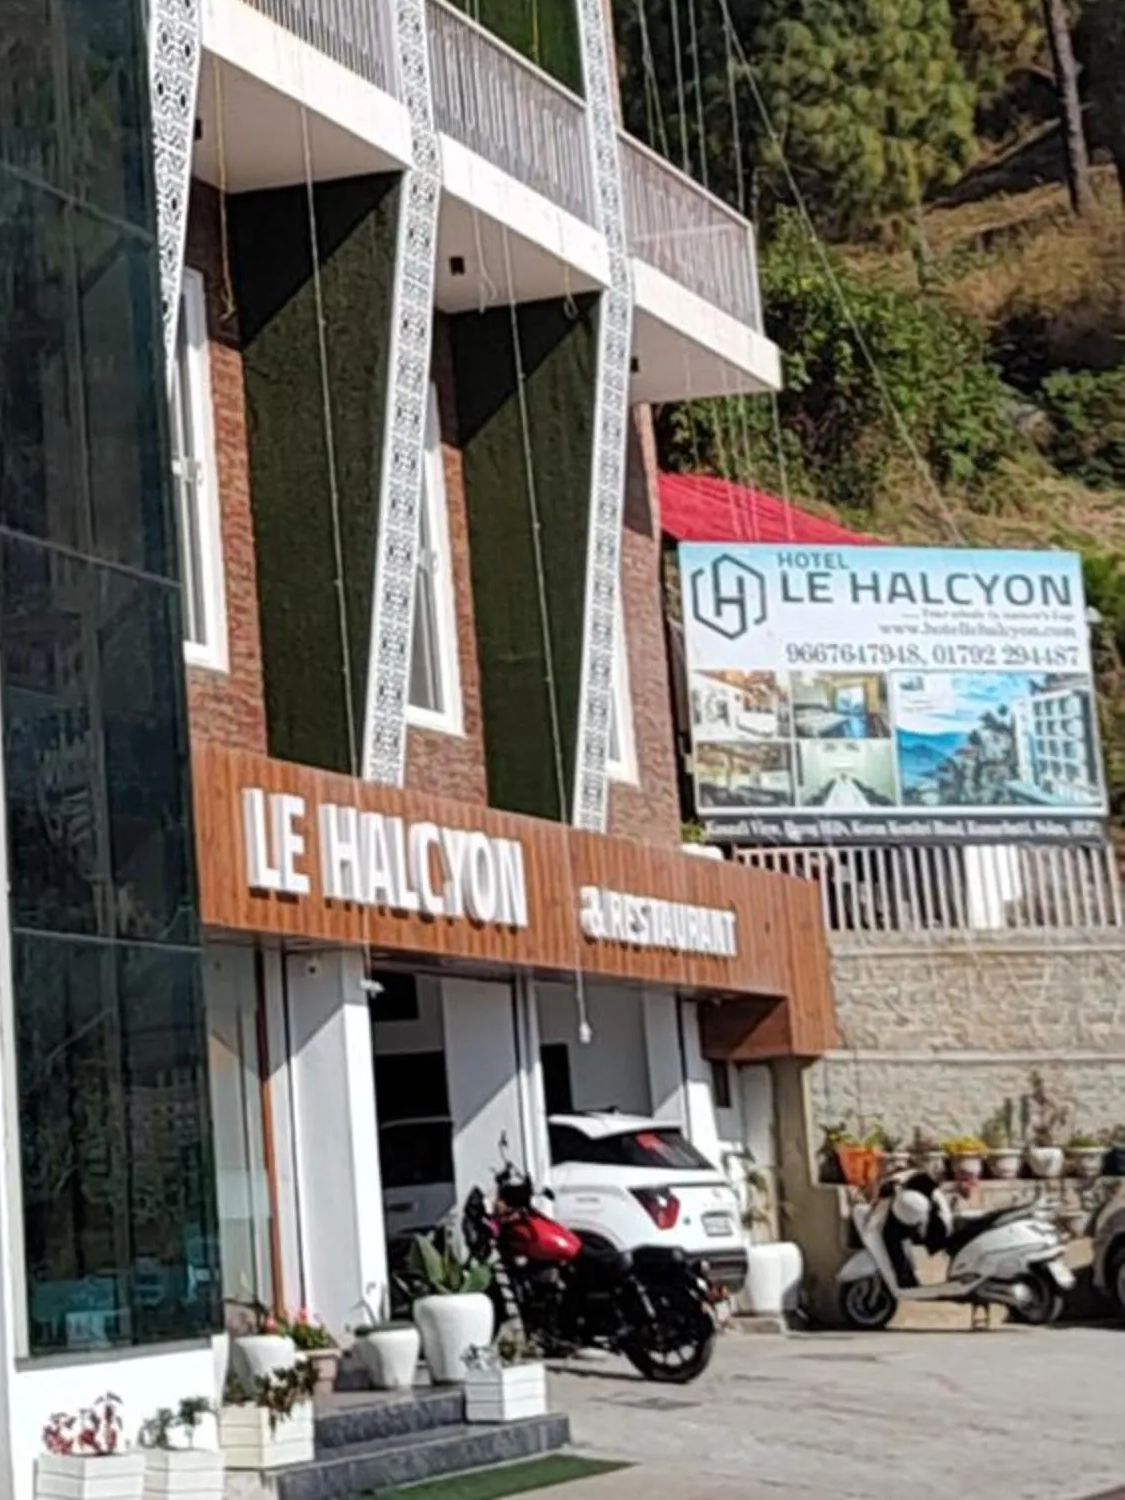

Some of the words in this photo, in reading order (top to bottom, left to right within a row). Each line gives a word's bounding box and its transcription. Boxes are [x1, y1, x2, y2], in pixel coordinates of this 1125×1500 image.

[777, 551, 849, 570] HOTEL
[780, 570, 834, 603] LE
[850, 571, 1072, 607] HALCYON
[241, 787, 310, 896] LE
[317, 802, 529, 928] HALCYON
[601, 887, 739, 958] RESTAURANT
